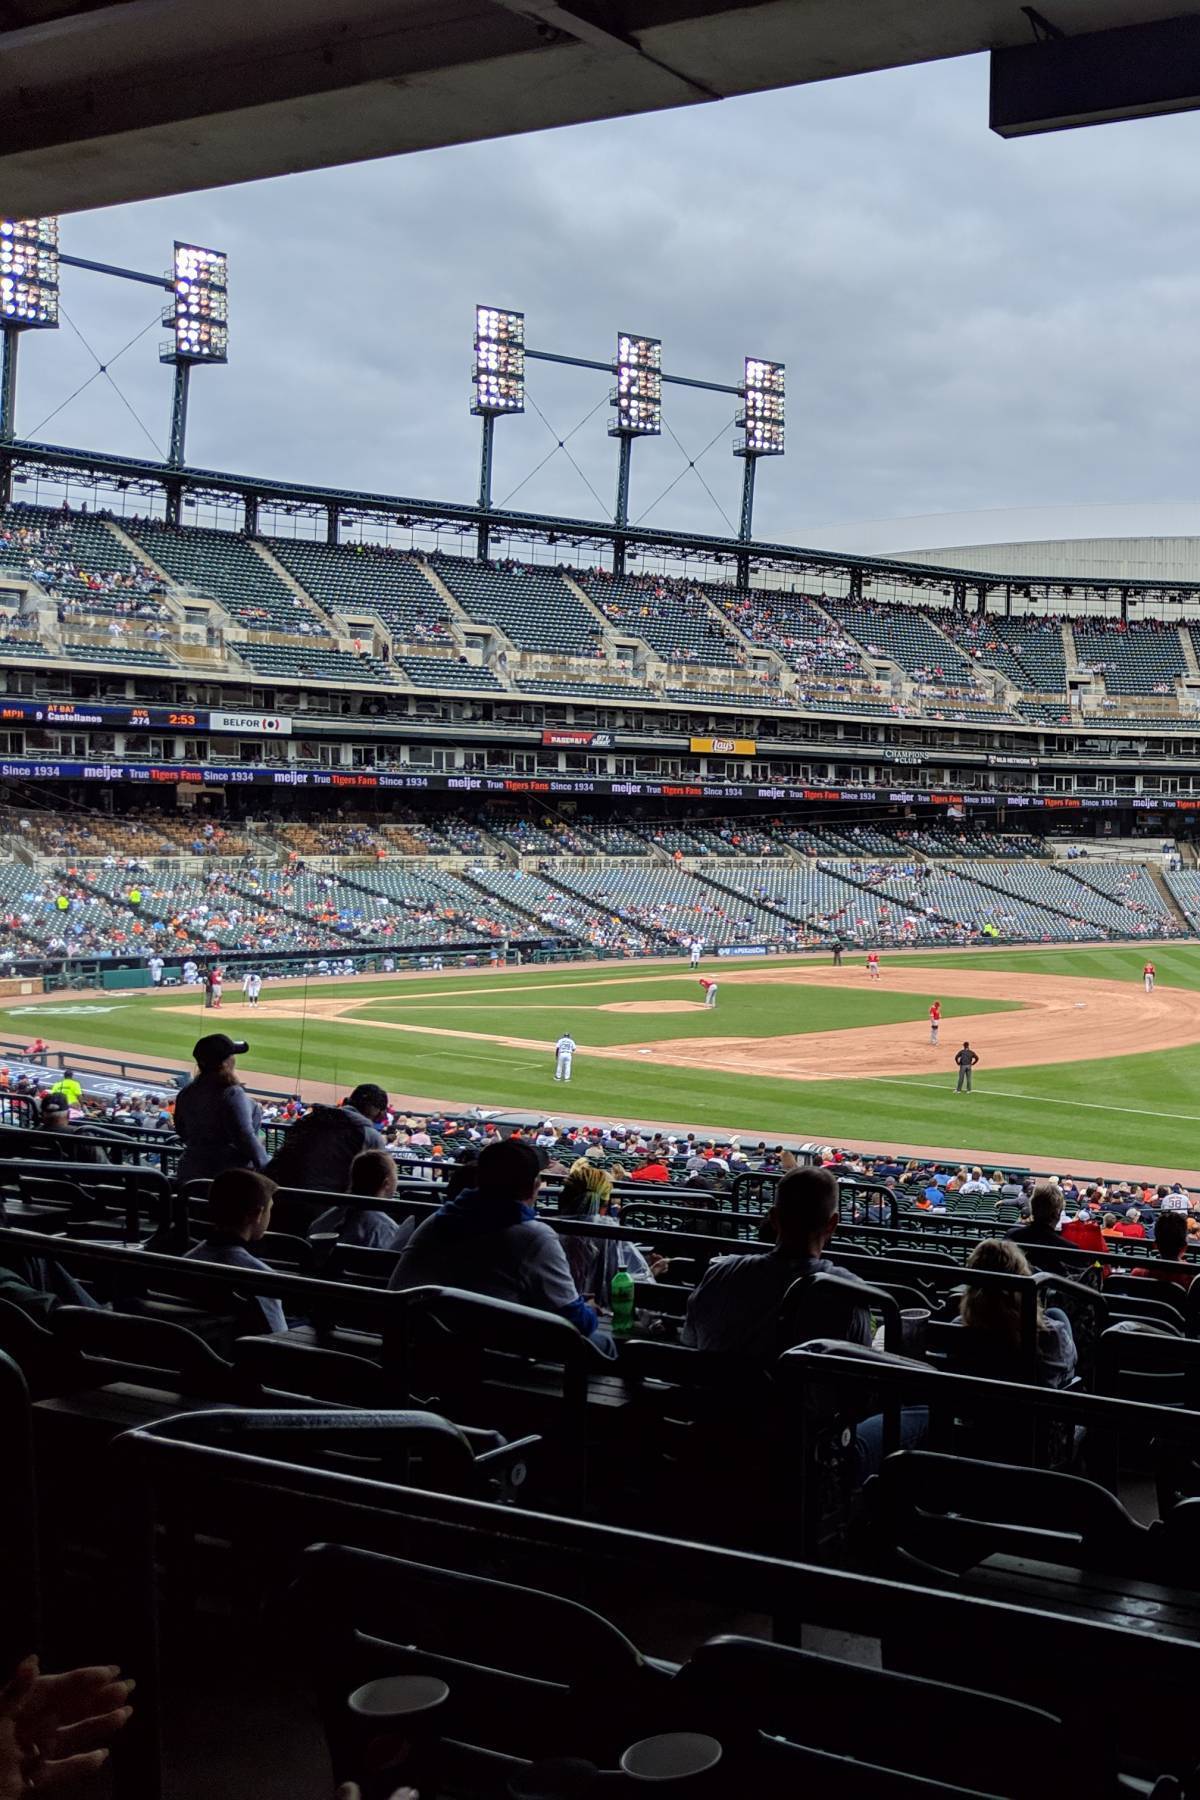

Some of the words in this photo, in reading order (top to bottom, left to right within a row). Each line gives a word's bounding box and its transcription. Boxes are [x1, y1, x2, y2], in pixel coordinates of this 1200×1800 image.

[3, 709, 24, 719] MPH
[35, 712, 43, 721] 9
[47, 712, 103, 723] Castellanos
[169, 714, 196, 725] 2:53
[129, 717, 150, 726] .274
[223, 718, 260, 728] BELFOR
[885, 750, 929, 760] CHAMPIONS
[3, 765, 30, 776] Since
[34, 766, 60, 777] 1934
[84, 766, 123, 781] meijer
[129, 769, 149, 779] True
[151, 769, 178, 781] Tigers
[181, 771, 202, 781] Fans
[204, 772, 228, 781] Since
[231, 772, 254, 782] 1934
[274, 772, 308, 785] meijer
[313, 775, 330, 784] True
[332, 775, 356, 786] Tigers
[358, 776, 377, 785] Fans
[379, 777, 403, 786] Since
[406, 778, 428, 787] 1934
[448, 777, 482, 790] meijer
[487, 780, 503, 789] True
[505, 781, 529, 792] Tigers
[530, 782, 549, 790] Fans
[551, 782, 572, 790] Since
[574, 783, 594, 791] 1934
[612, 782, 642, 795] meijer
[646, 785, 661, 793] True
[686, 786, 702, 795] Fans
[704, 787, 723, 795] Since
[725, 788, 743, 796] 1934
[759, 788, 785, 800] meijer
[841, 792, 858, 800] Since
[860, 792, 876, 800] 1934
[890, 792, 914, 803] meijer
[1008, 796, 1029, 807] meijer
[1133, 799, 1158, 809] meijer
[1169, 1200, 1181, 1209] 38
